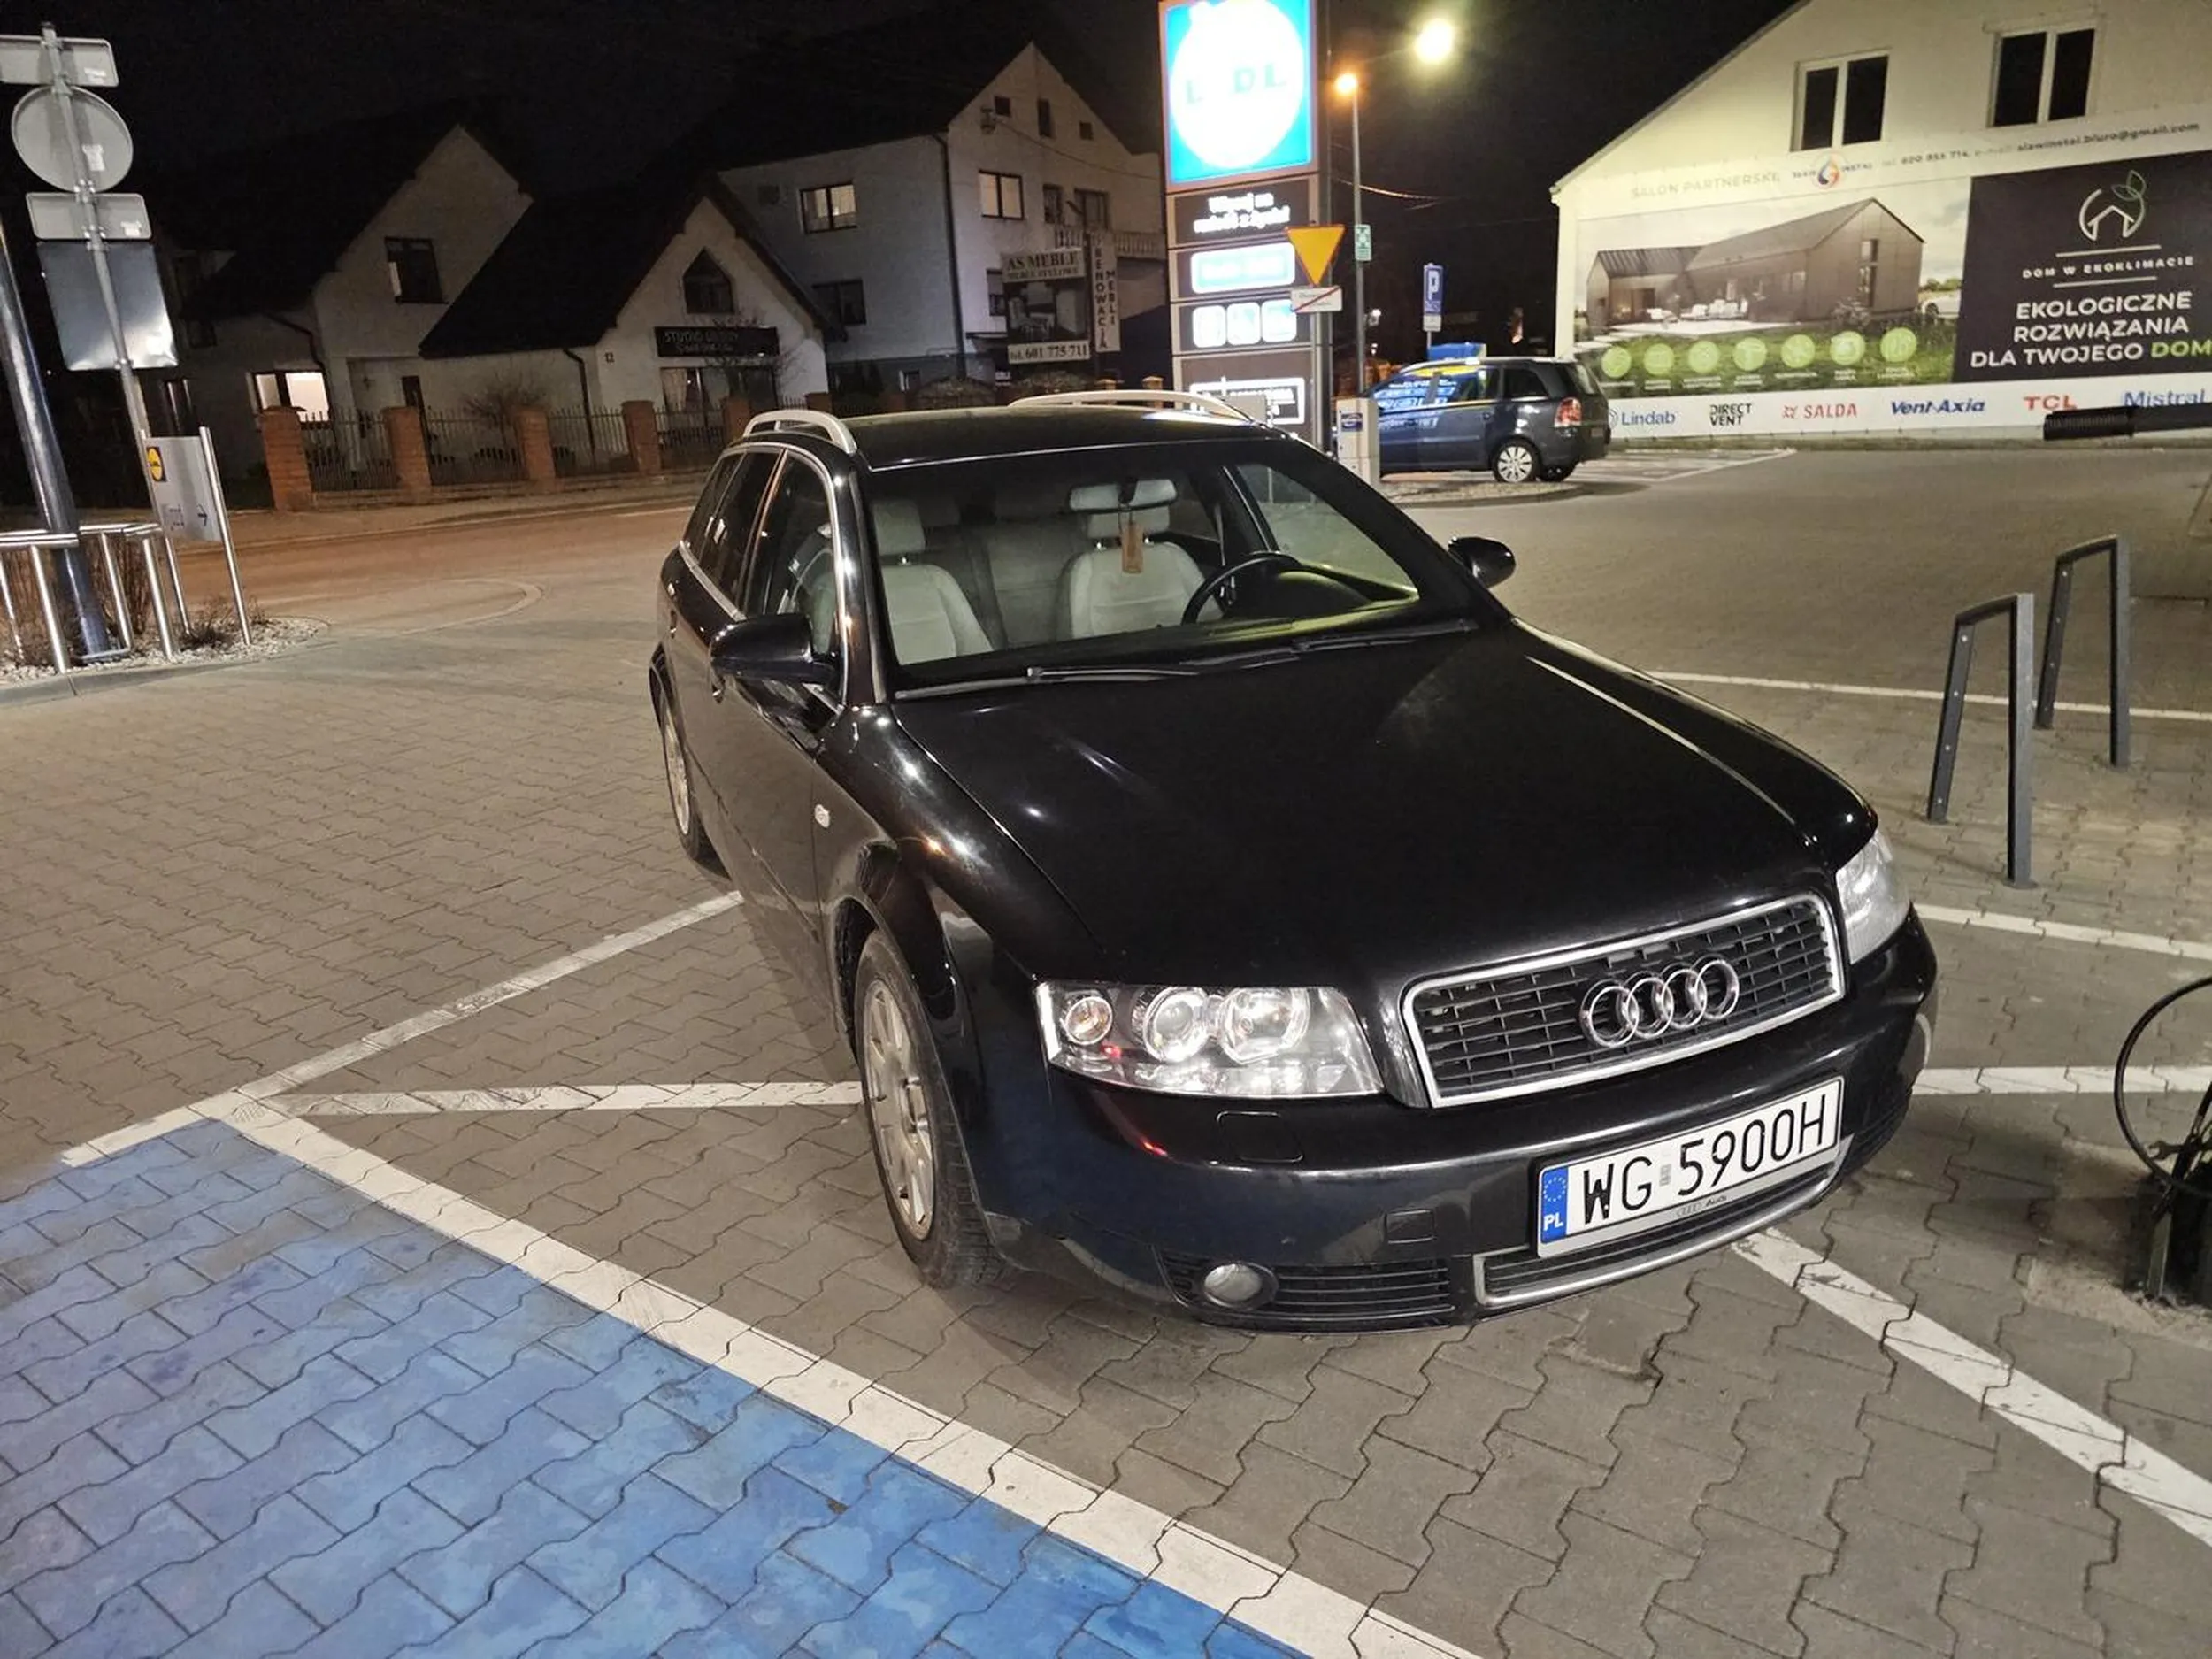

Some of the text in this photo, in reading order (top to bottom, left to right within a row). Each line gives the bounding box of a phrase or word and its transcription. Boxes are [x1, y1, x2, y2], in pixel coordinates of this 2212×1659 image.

[1185, 62, 1287, 104] LDL
[2022, 255, 2194, 279] DOM W EKOKLIMACIE
[1427, 270, 1440, 300] P
[2016, 290, 2193, 320] EKOLOGICZNE
[2013, 315, 2190, 343] ROZWIĄZANIA
[1970, 349, 2017, 368] DLA
[2024, 342, 2144, 365] TWOJEGO
[1891, 398, 1986, 415] Vent-Axia
[2024, 395, 2078, 411] TCL
[2122, 388, 2206, 408] Mistral
[1621, 410, 1676, 426] Lindab
[1709, 403, 1753, 417] DIRECT
[1709, 414, 1742, 426] VENT
[1803, 403, 1858, 419] SALDA
[1583, 1094, 1827, 1225] WG 5900H
[1543, 1213, 1564, 1232] PL
